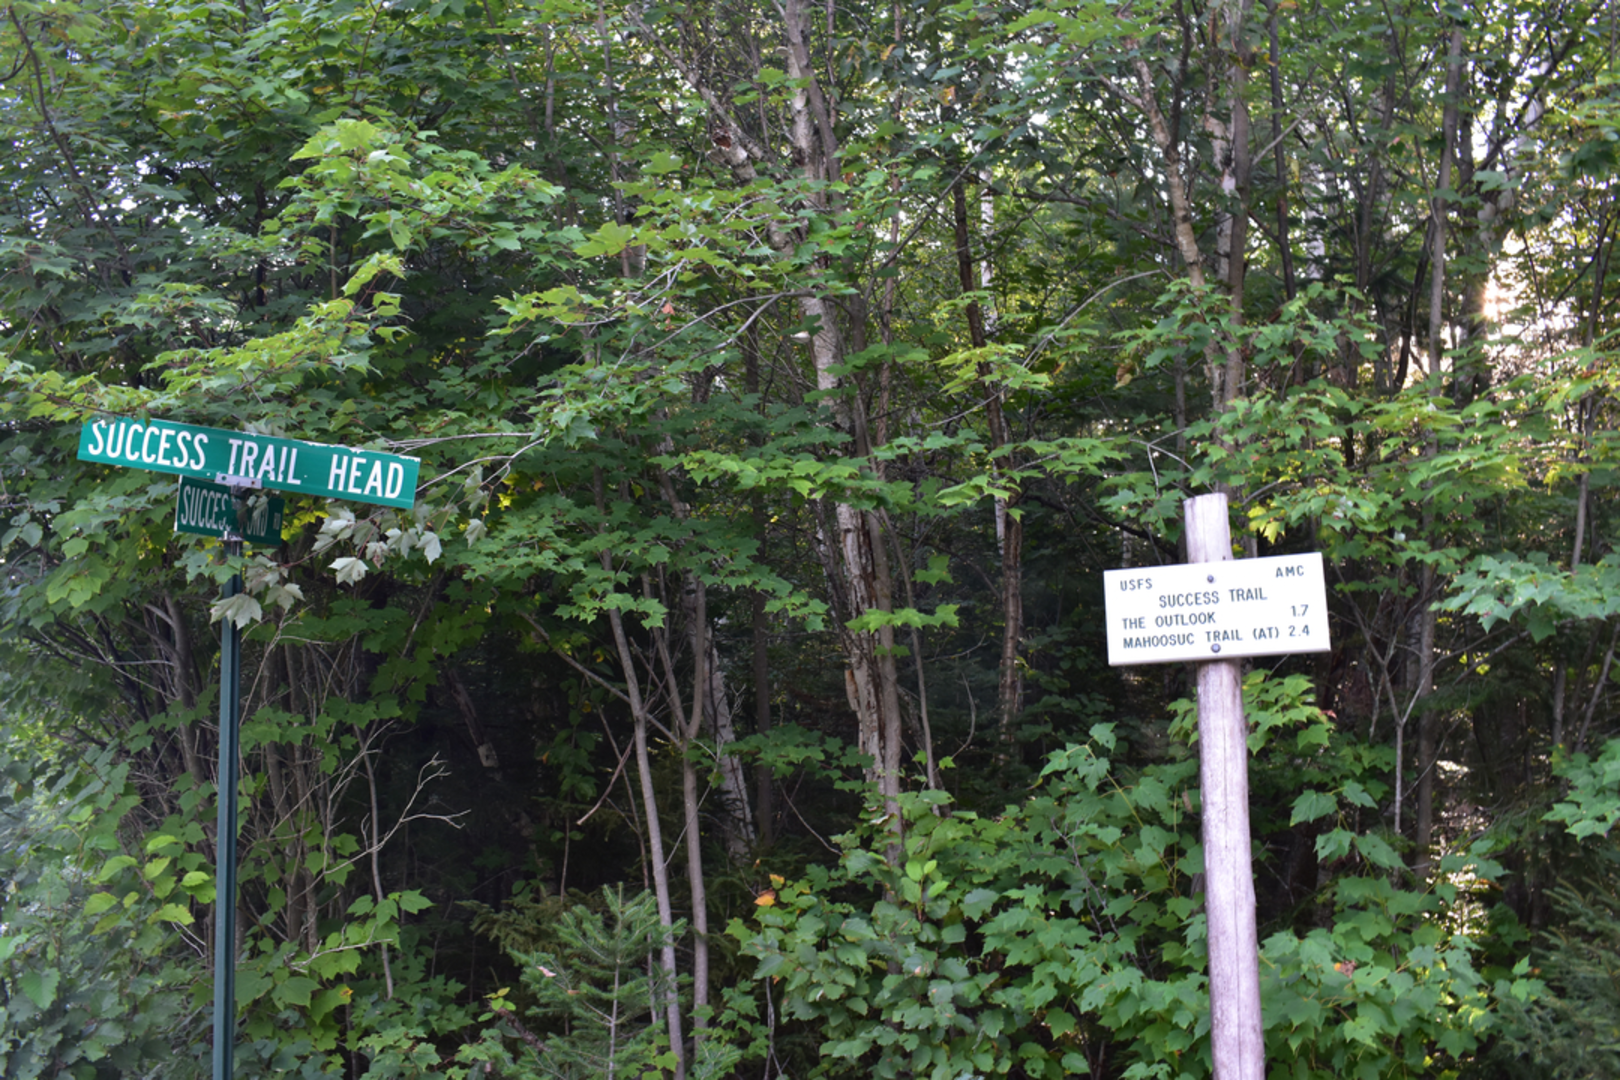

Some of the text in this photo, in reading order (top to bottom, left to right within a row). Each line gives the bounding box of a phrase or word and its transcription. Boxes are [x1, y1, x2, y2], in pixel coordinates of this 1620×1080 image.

[88, 419, 404, 499] SUCCESS TRAIL HEAD
[180, 484, 232, 532] SUCCES
[1120, 565, 1305, 591] USFS AMC
[1158, 587, 1268, 608] SUCCESS TRAIL
[1122, 604, 1309, 630] THE OUTLOOK 1.7
[1123, 625, 1310, 649] MAHOOSUC TRAIL (AT) 2.4
